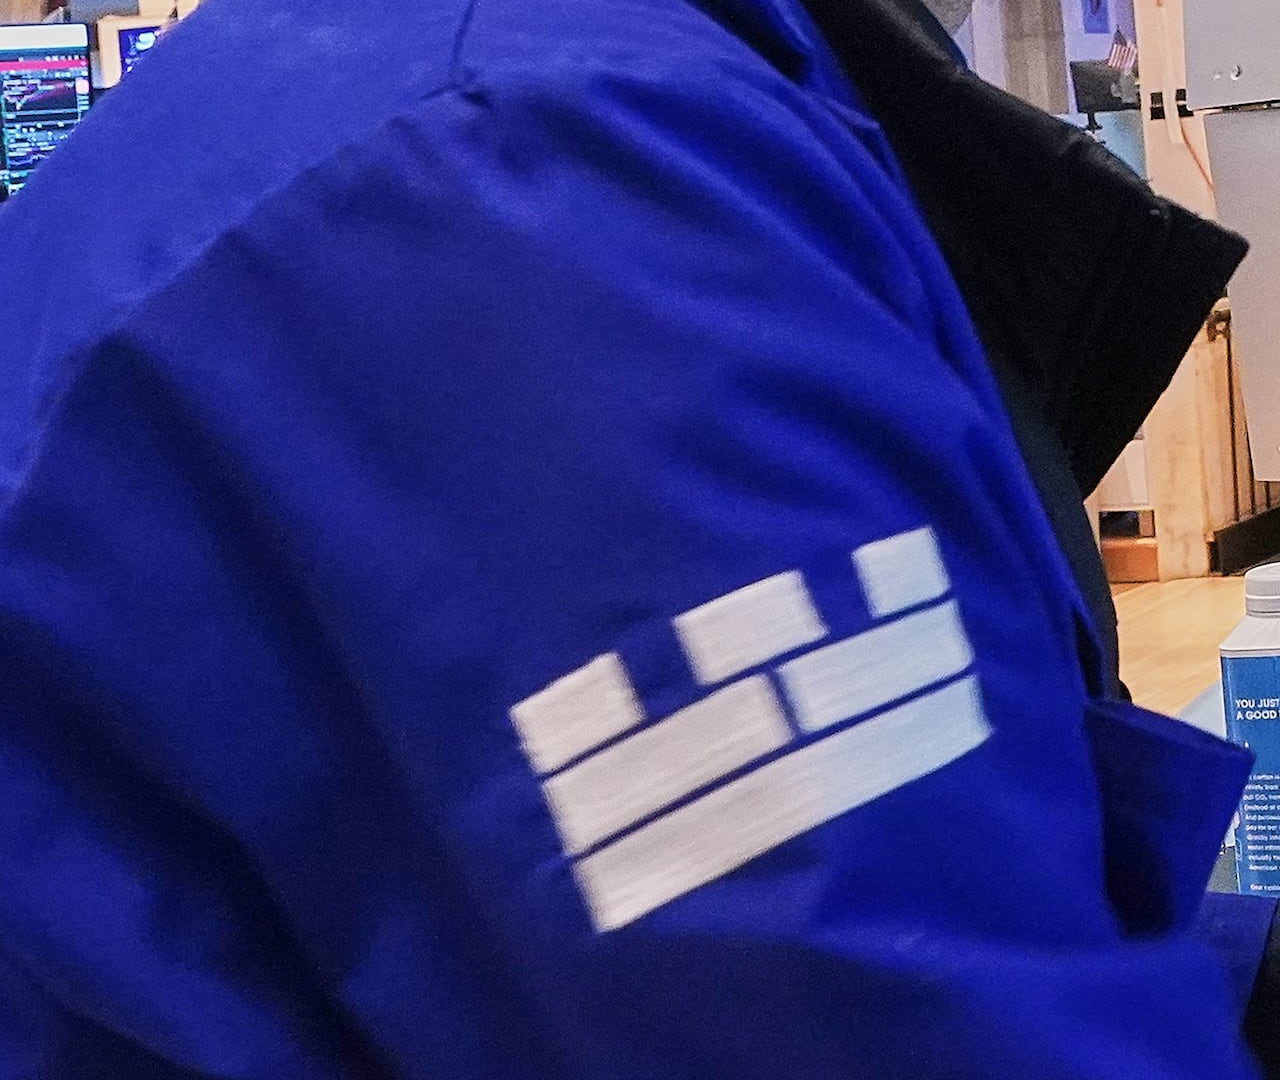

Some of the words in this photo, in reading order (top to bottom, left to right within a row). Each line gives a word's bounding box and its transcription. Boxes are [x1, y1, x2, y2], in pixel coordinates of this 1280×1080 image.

[1235, 698, 1256, 709] YOU
[1257, 698, 1280, 708] JUST
[1236, 710, 1244, 721] A
[1245, 709, 1277, 721] GOOD
